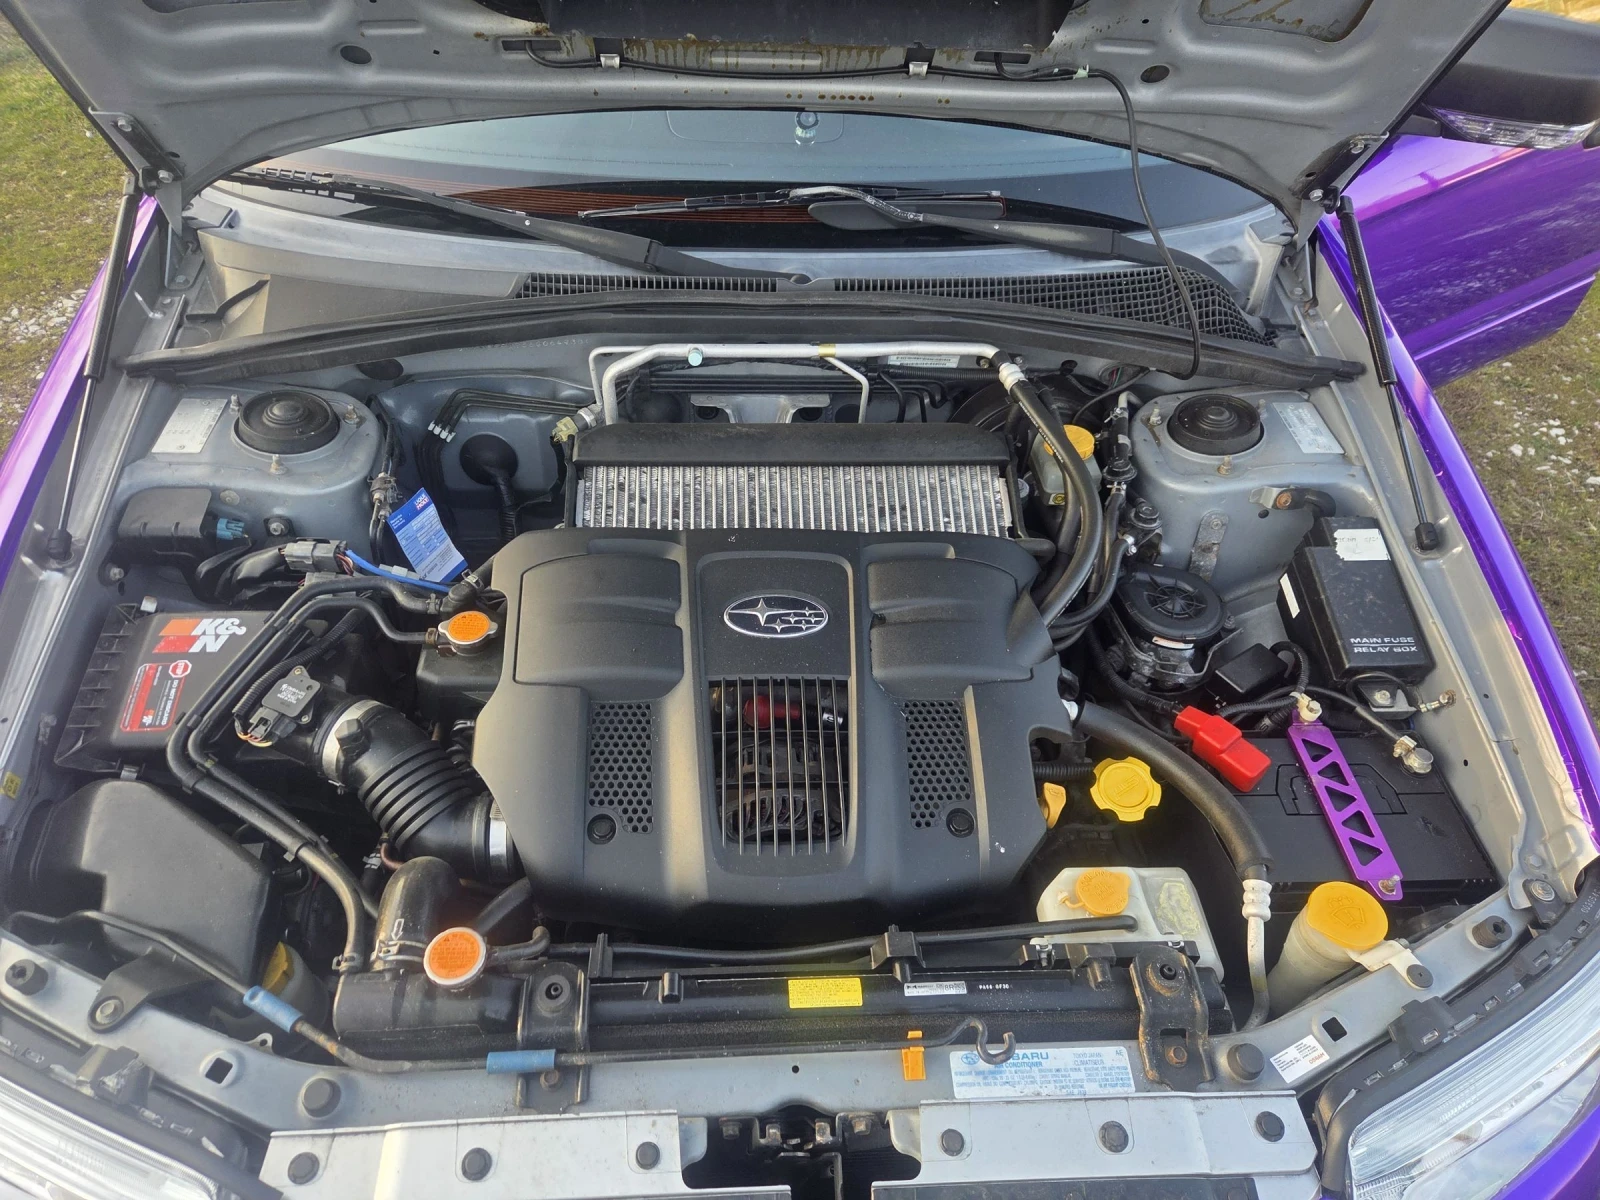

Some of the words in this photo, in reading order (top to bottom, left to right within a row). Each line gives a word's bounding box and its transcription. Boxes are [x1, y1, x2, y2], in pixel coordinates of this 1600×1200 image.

[172, 679, 179, 687] DO
[993, 1051, 1049, 1062] BARU
[1309, 1052, 1325, 1064] OSRAM
